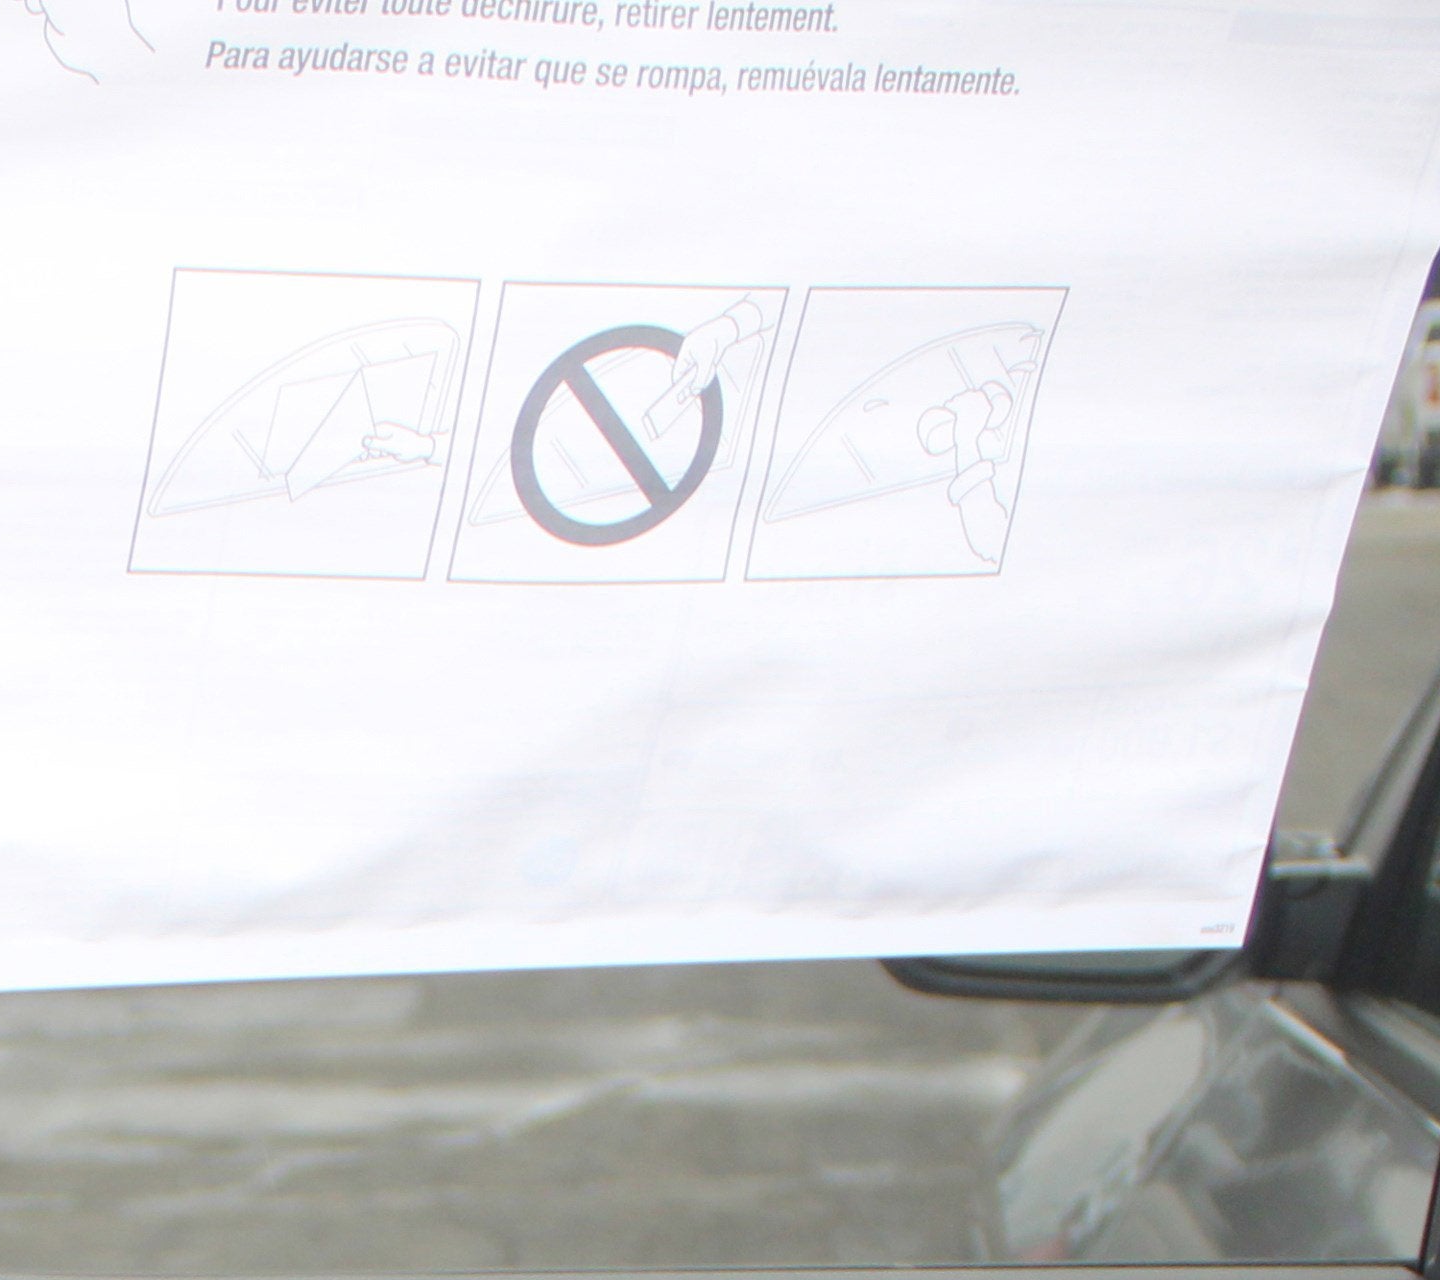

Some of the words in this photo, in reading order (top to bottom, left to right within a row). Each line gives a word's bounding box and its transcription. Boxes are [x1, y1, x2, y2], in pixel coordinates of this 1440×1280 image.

[614, 0, 699, 30] retirer
[706, 0, 838, 32] lentement.
[205, 40, 270, 69] Para
[278, 42, 409, 76] ayudarse
[418, 50, 434, 76] a
[444, 48, 527, 81] evitar
[534, 57, 587, 89] que
[595, 63, 628, 87] se
[636, 65, 728, 97] rompa,
[737, 60, 866, 94] remuévala
[874, 63, 1021, 96] lentamente.
